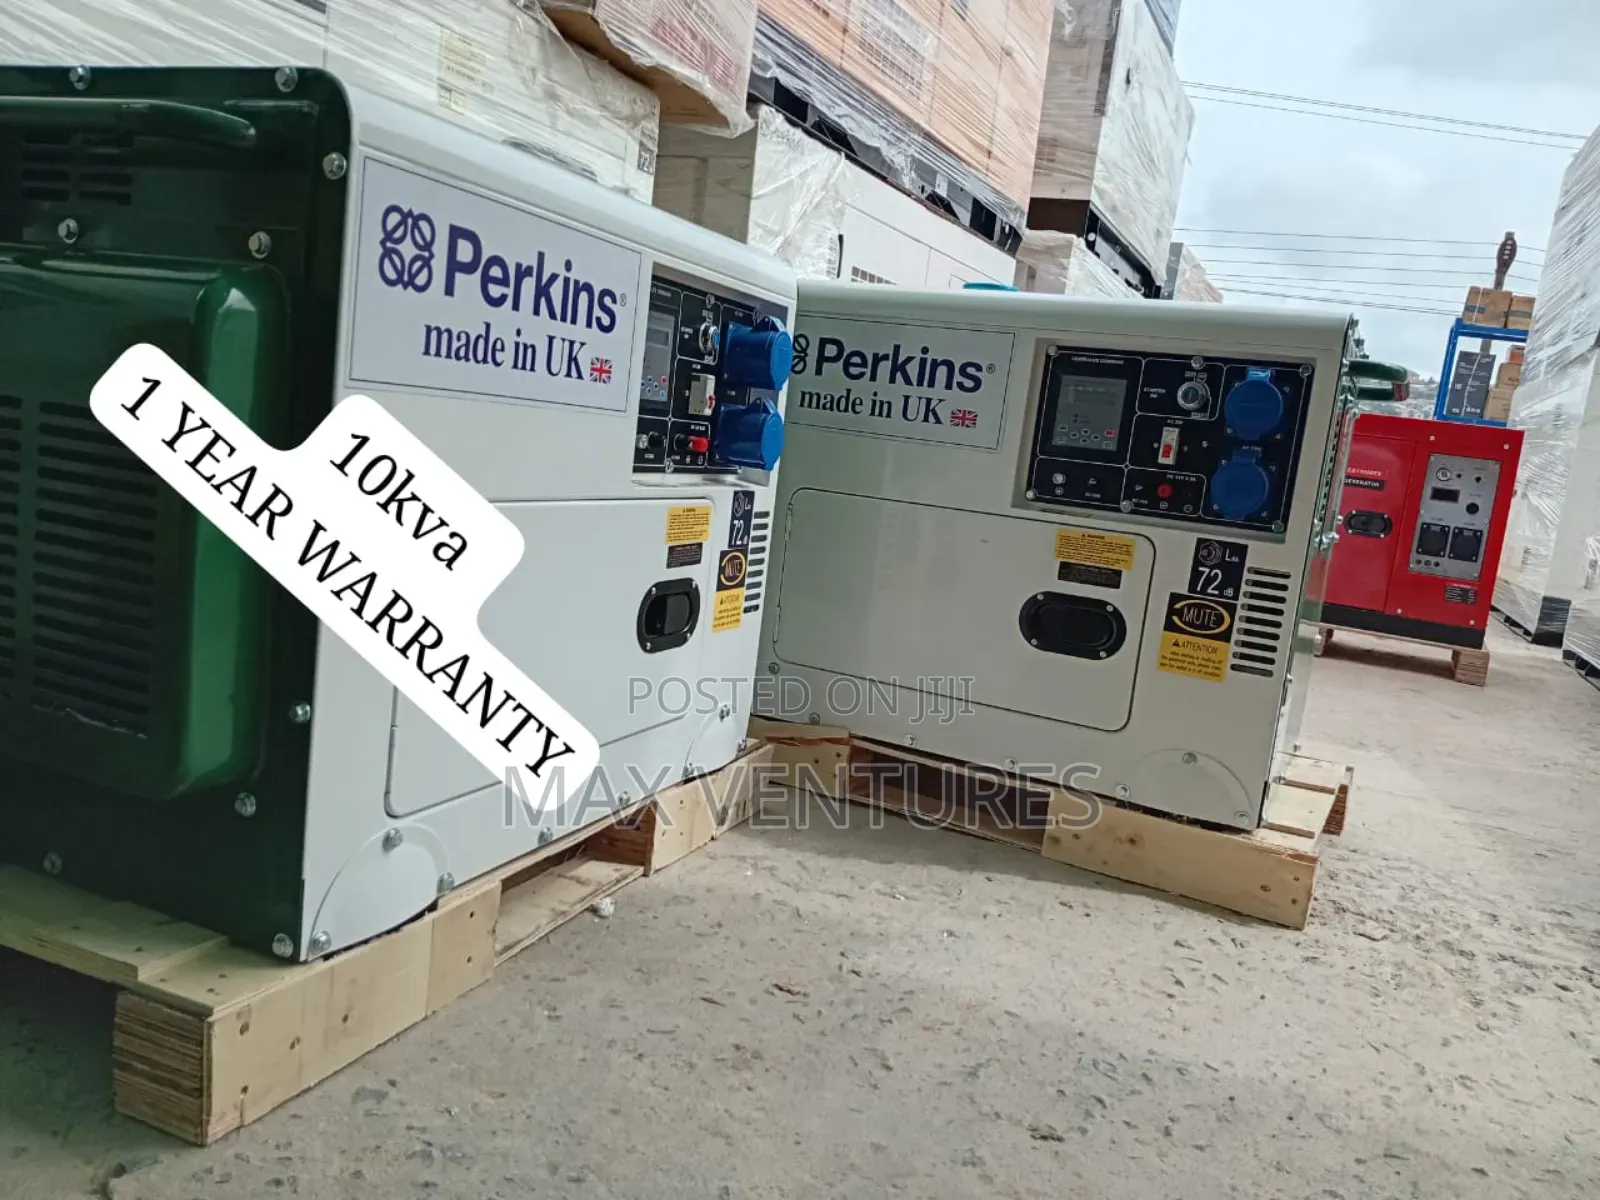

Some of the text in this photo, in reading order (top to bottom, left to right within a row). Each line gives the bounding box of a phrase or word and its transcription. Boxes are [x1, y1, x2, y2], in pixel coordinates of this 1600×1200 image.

[422, 321, 586, 380] made in UK
[799, 388, 947, 425] made in UK
[732, 519, 744, 546] 72
[1197, 567, 1222, 595] 72
[1182, 606, 1220, 628] MUTE
